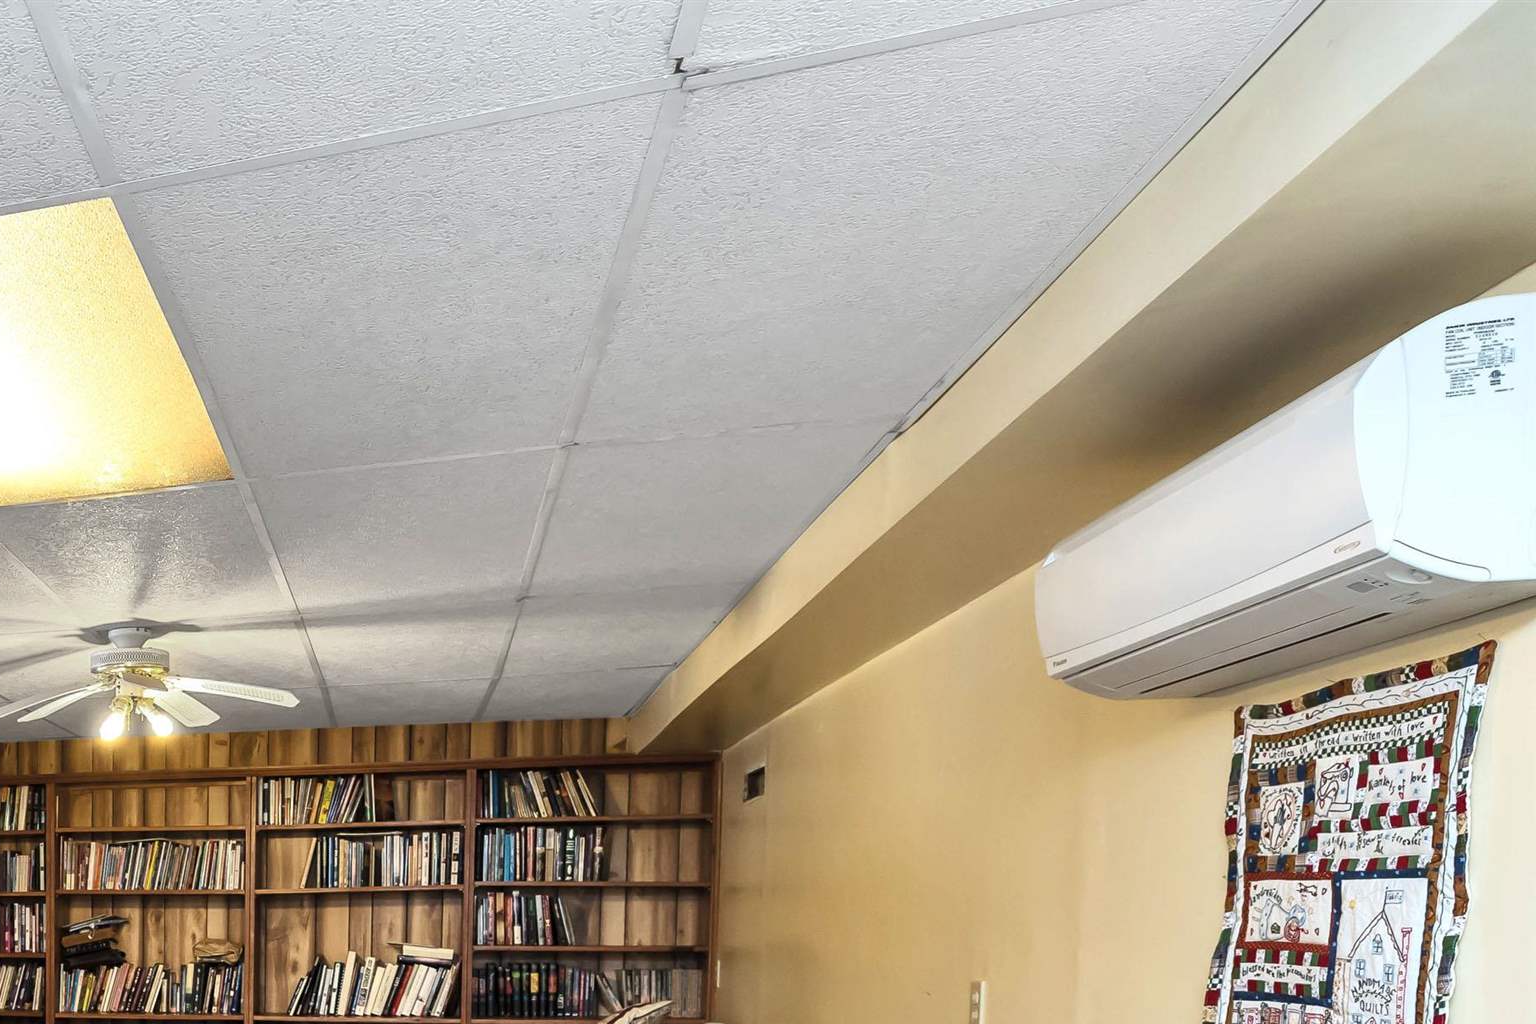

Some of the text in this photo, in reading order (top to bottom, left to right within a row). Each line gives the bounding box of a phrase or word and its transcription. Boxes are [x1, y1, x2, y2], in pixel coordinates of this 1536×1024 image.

[1314, 736, 1340, 750] thread
[1384, 723, 1402, 738] with
[1407, 720, 1424, 733] love
[1359, 999, 1390, 1017] QUILTS
